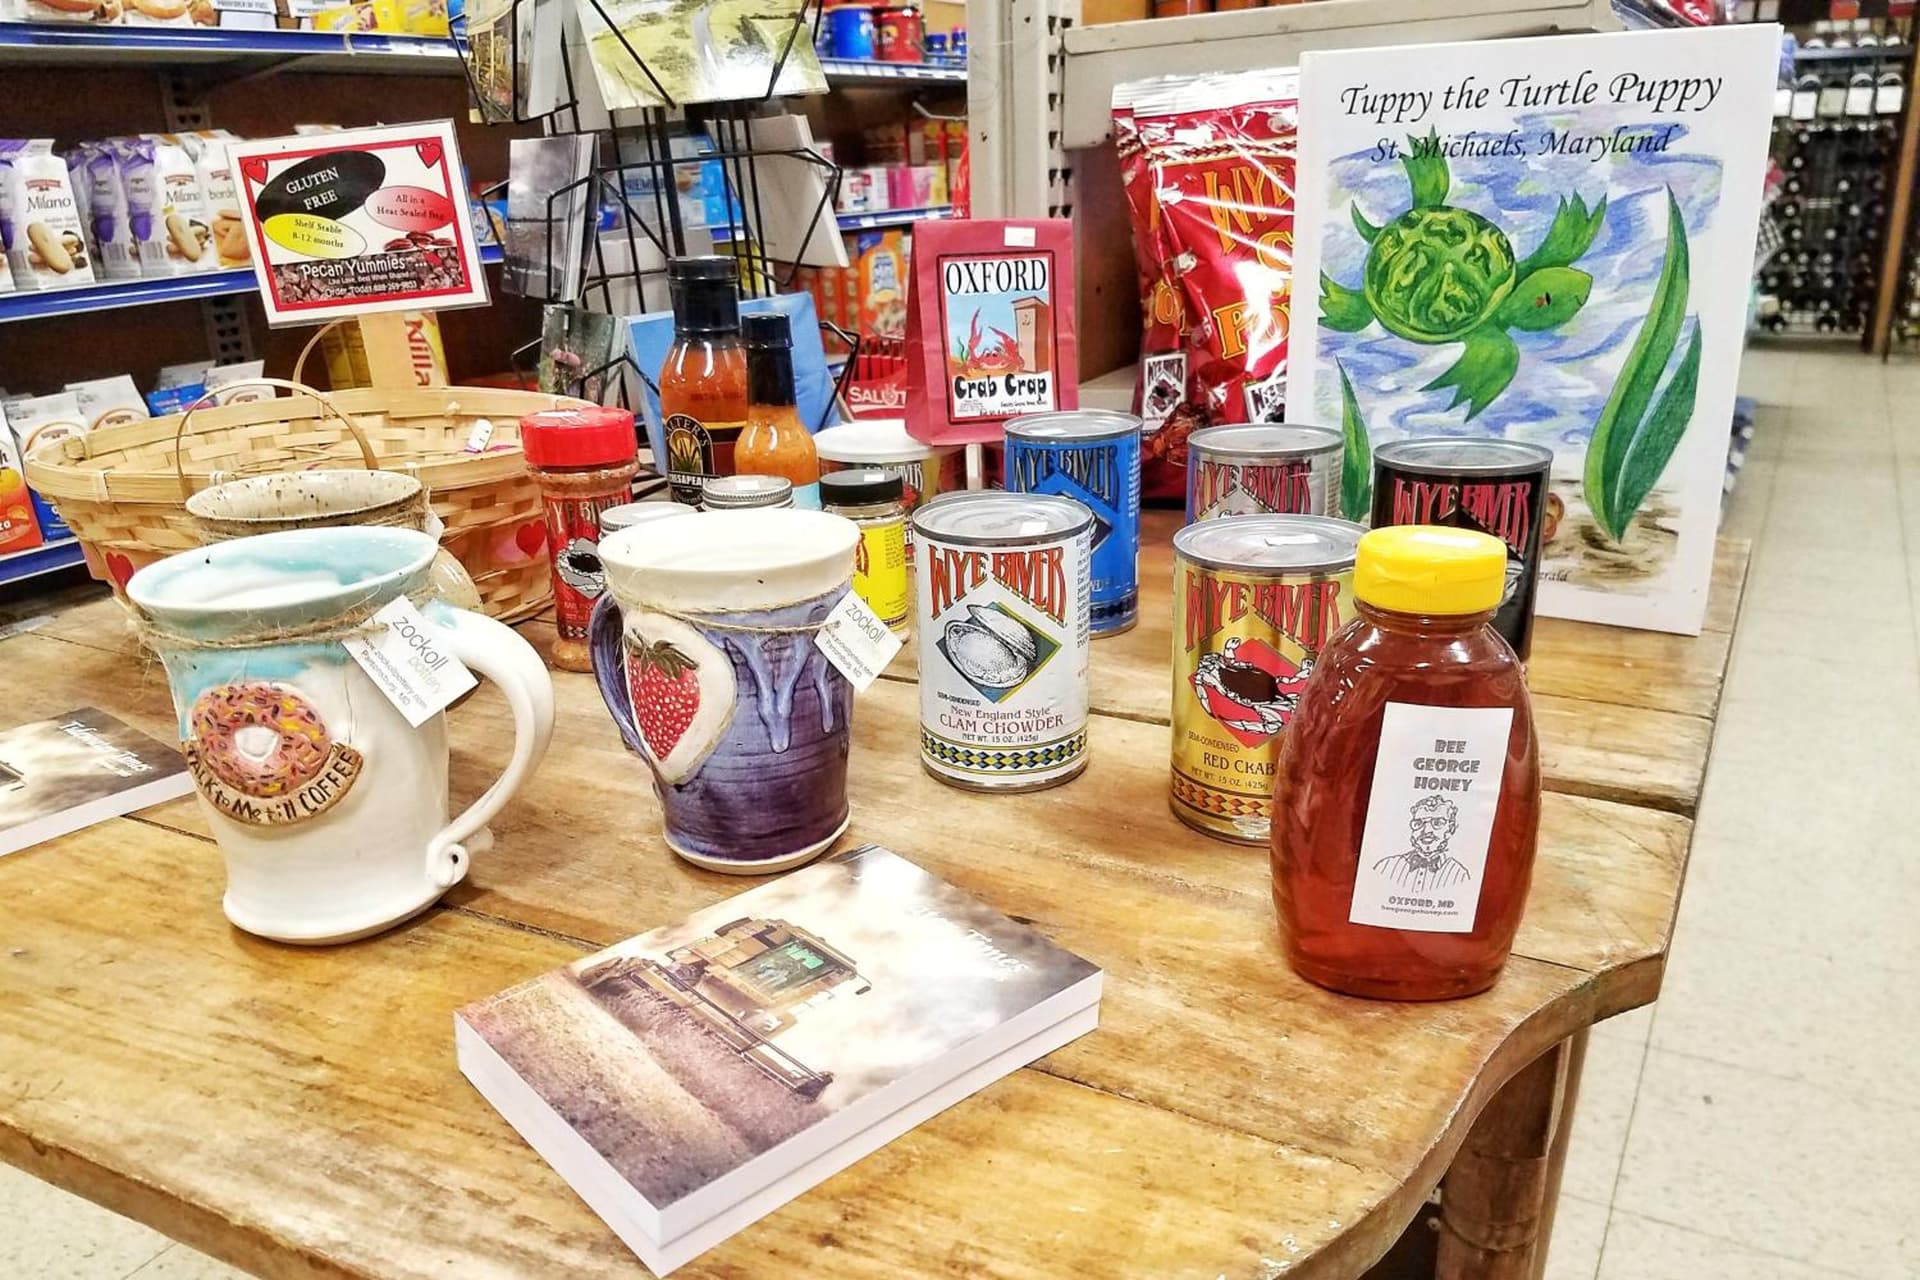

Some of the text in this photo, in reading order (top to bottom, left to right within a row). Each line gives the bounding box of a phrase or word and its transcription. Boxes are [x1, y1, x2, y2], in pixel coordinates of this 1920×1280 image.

[1340, 70, 1723, 124] Tuppy the Turtle Puppy
[1371, 124, 1673, 163] St. Michaels, Maryland
[285, 167, 340, 195] GLUTEN
[26, 194, 72, 213] Milano
[304, 189, 338, 211] FREE
[395, 194, 409, 204] All
[376, 206, 399, 216] Heat
[399, 206, 426, 218] Sealed
[294, 218, 342, 234] Shelf Stable
[292, 233, 344, 248] 8-12 months
[301, 262, 343, 280] Pecan
[344, 255, 406, 276] Yummies
[945, 259, 1047, 295] OXFORD
[324, 287, 347, 298] Order
[349, 284, 372, 295] Today
[404, 320, 433, 387] Nilla
[954, 373, 1047, 402] Crab Crap
[1011, 446, 1056, 494] WYE
[1058, 445, 1121, 514] RIVER
[1241, 460, 1313, 515] RIVER
[1393, 478, 1459, 526] WYE
[1461, 481, 1531, 561] RIVER
[927, 543, 989, 622] WYE
[991, 546, 1068, 630] RIVER
[845, 603, 886, 643] zockoll
[1185, 570, 1251, 653] WYE
[1252, 580, 1342, 656] RIVER
[392, 616, 449, 671] zockoll
[939, 713, 1065, 735] CLAM CHOWDER
[950, 704, 1051, 721] New England Style
[962, 733, 976, 741] NET
[977, 734, 990, 743] WT.
[991, 735, 1001, 743] 15
[1002, 735, 1015, 744] OZ.
[1434, 739, 1467, 754] BEE
[1203, 752, 1276, 777] RED CRAB
[1413, 757, 1481, 774] GEORGE
[232, 799, 261, 822] Me
[299, 750, 356, 814] COFFEE
[1218, 775, 1228, 784] 15
[1413, 776, 1473, 792] HONEY
[1388, 895, 1455, 910] OXFORD, MD
